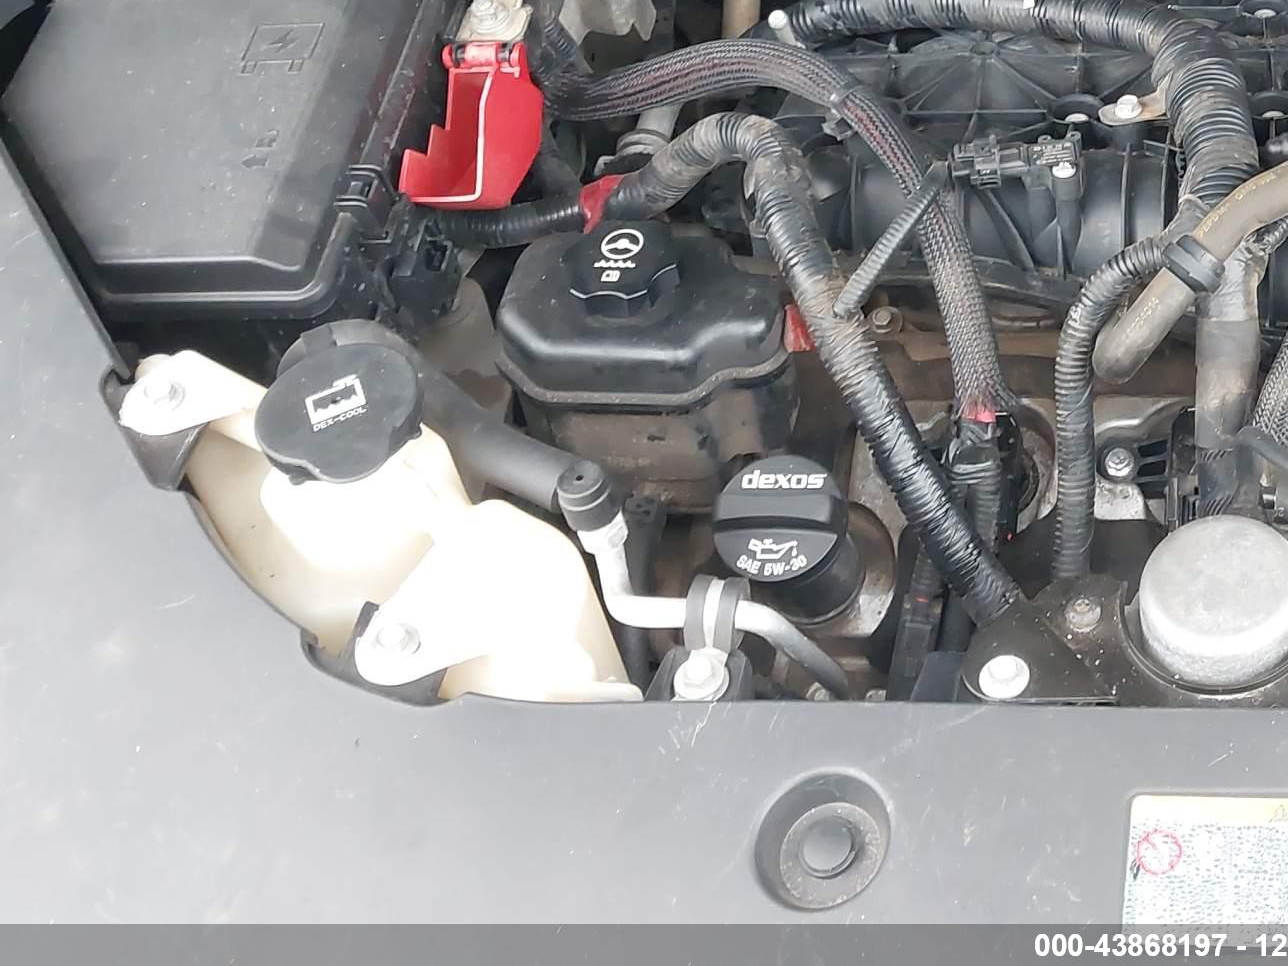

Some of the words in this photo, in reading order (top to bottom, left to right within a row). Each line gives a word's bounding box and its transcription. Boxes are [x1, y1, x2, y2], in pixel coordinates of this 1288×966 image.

[312, 406, 369, 432] DEX-COOL
[741, 469, 828, 489] dexos
[736, 554, 762, 575] SAE
[763, 554, 808, 576] 5W-30
